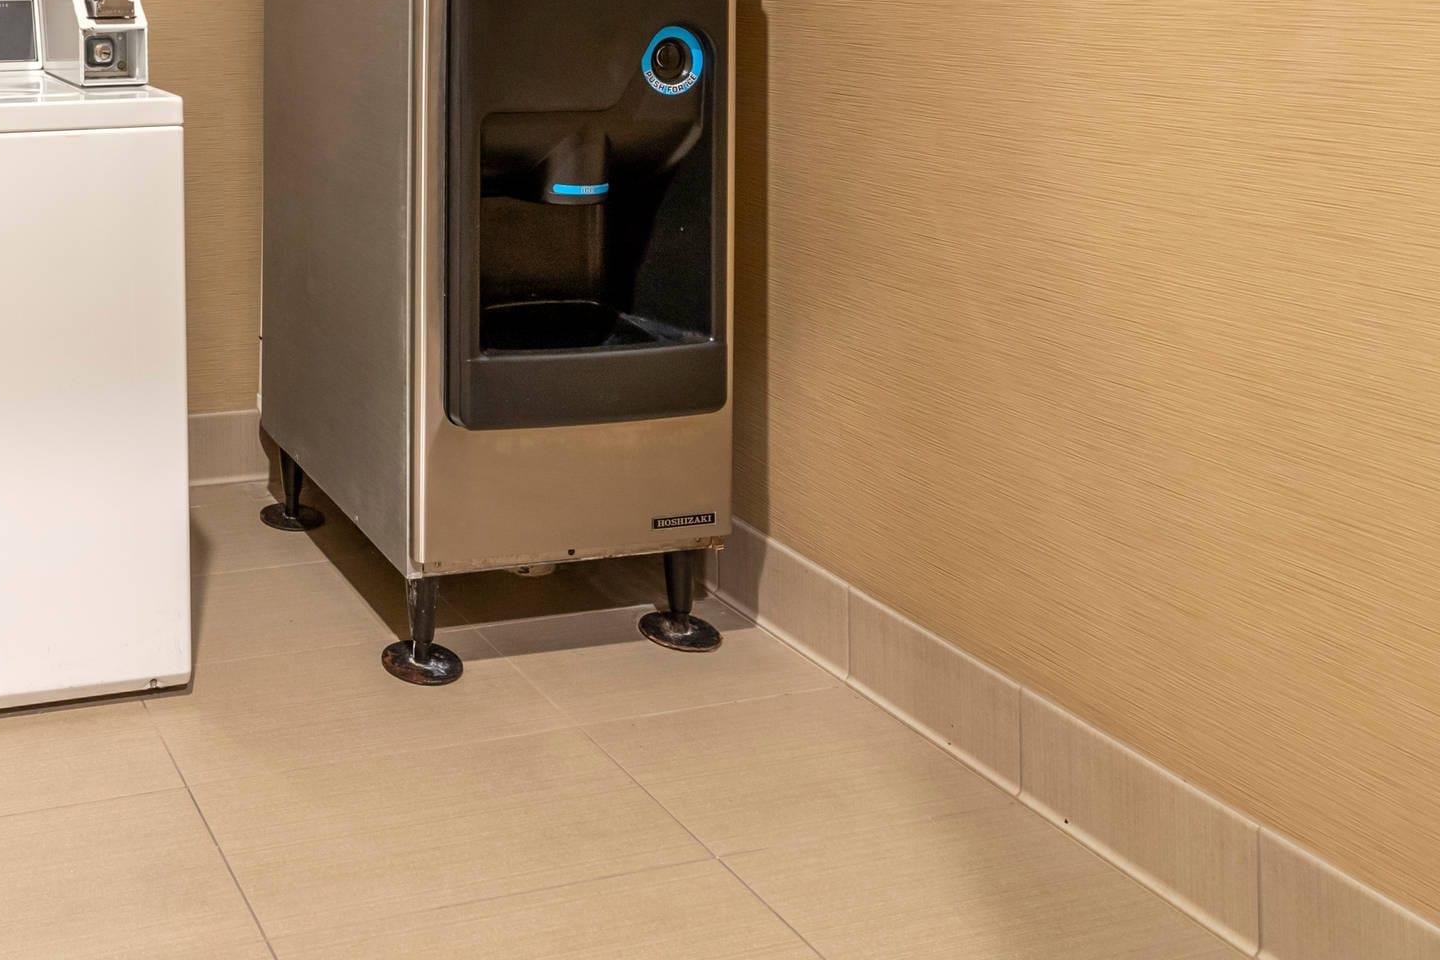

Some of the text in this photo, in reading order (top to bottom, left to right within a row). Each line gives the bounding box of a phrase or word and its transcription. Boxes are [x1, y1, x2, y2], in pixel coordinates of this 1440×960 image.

[646, 70, 665, 91] PUSH
[667, 84, 684, 93] FOR
[657, 515, 712, 527] HOSHIZAKI
